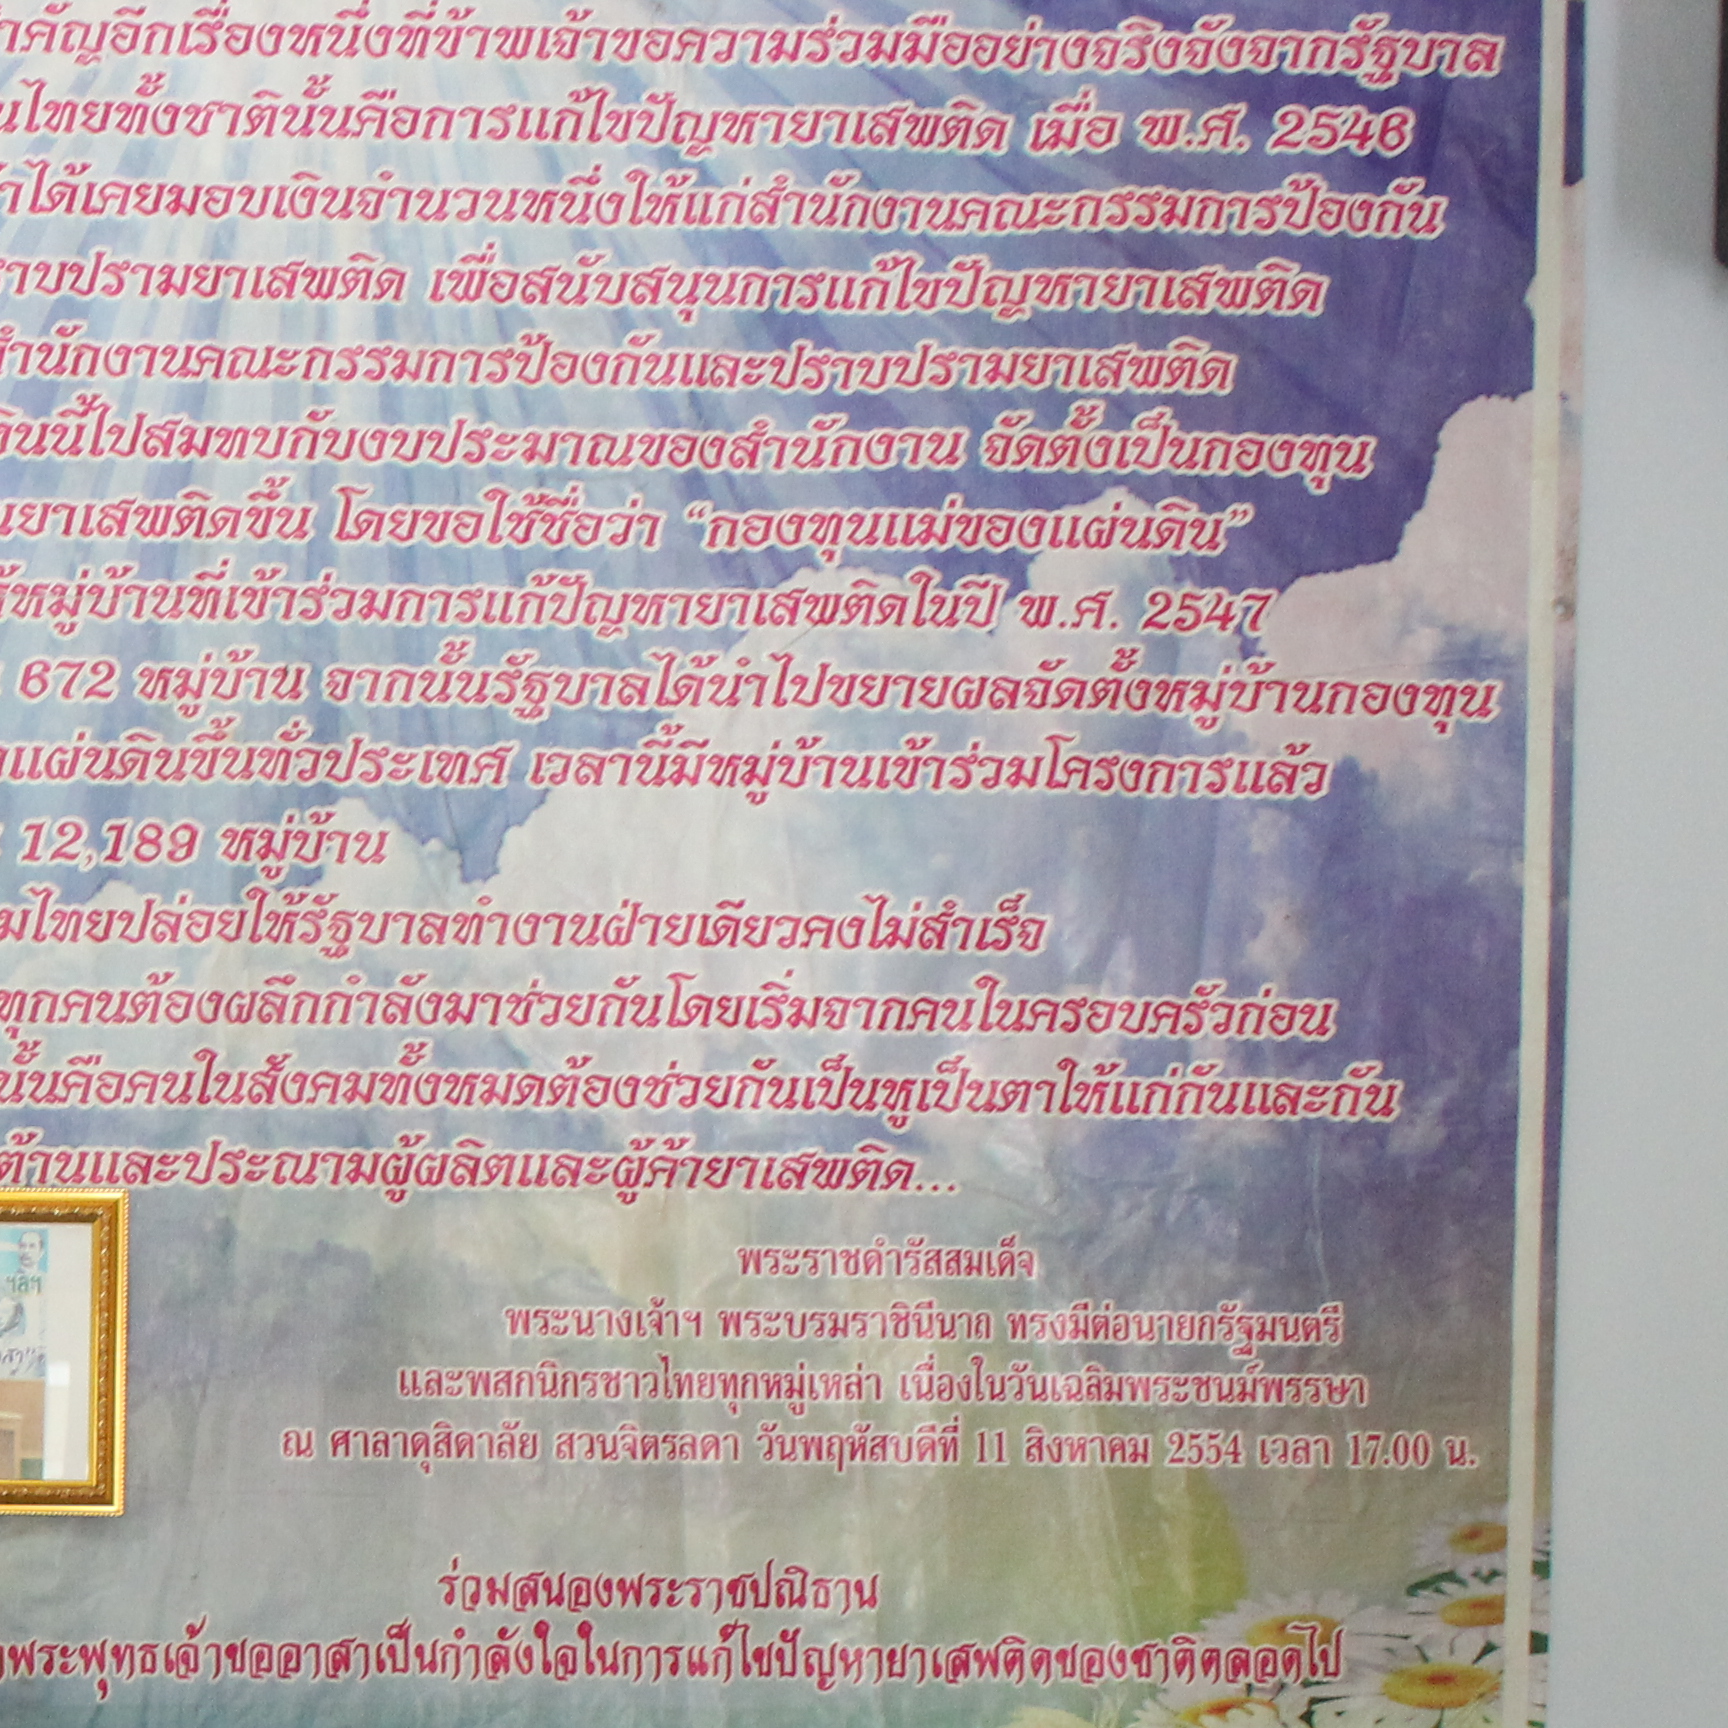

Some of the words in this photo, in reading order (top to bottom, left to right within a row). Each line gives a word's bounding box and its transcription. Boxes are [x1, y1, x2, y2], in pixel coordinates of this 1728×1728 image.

[1030, 91, 1118, 152] เมื่อ
[1141, 109, 1245, 149] พ.ศ.
[1271, 110, 1410, 152] 2546
[985, 405, 1371, 490] จัดตั้งเป็นกองทุน
[335, 486, 661, 547] โดยขอใช้ชื่อว่า
[688, 499, 1253, 563] “กองทุนแม่ของแผ่นดิน”
[1018, 591, 1118, 630] พ.ศ.
[1142, 591, 1273, 633] 2547
[20, 660, 116, 700] 672
[139, 650, 305, 718] หมู่บ้าน
[22, 822, 199, 863] 12,189
[221, 811, 388, 881] หมู่บ้าน
[737, 1233, 1036, 1280] พระราชดำรัสสมเด็จ
[504, 1296, 702, 1339] พระนางเจ้าฯ
[718, 1302, 992, 1342] พระบรมราชินีนาถ
[1006, 1302, 1344, 1358] ทรงมีต่อนายกรัฐมนตรี
[398, 1353, 883, 1417] และพสกนิกรชาวไทยทุกหมู่เหล่า
[281, 1430, 313, 1460] ณ
[330, 1419, 539, 1475] ศาลาดุสิดาลัย
[555, 1423, 740, 1463] สวนจิตรลดา
[756, 1415, 959, 1473] วันพฤหัสบดีที่
[975, 1433, 1006, 1466] 11
[1024, 1427, 1151, 1467] สิงหาคม
[1166, 1432, 1243, 1468] 2554
[1258, 1434, 1332, 1469] เวลา
[1348, 1431, 1430, 1469] 17.00
[1446, 1436, 1479, 1470] น.
[437, 1558, 880, 1614] ร่วมสนองพระราชปณิธาน
